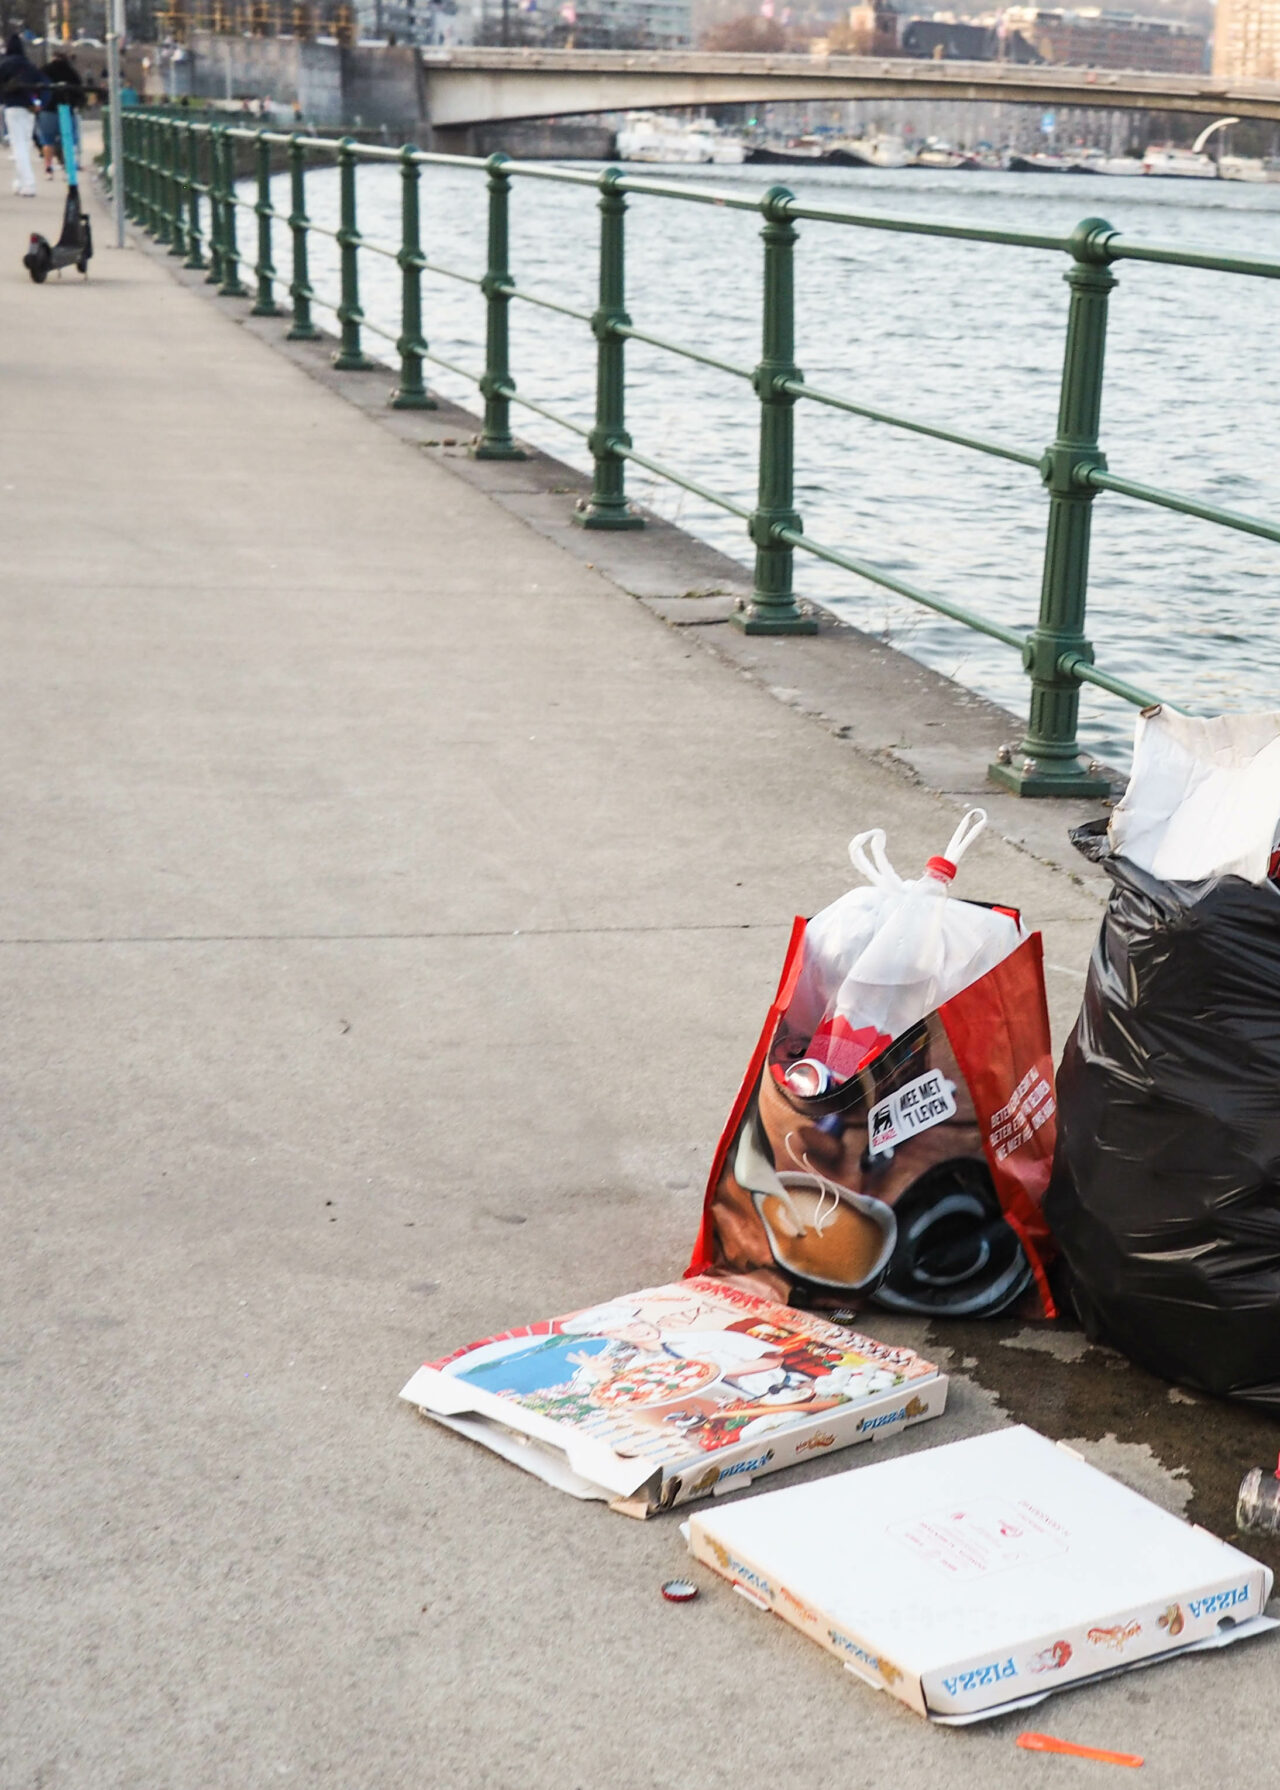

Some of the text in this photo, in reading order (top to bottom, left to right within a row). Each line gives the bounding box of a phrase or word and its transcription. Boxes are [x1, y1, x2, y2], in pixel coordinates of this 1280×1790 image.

[919, 1077, 941, 1101] MET
[914, 1095, 949, 1124] LEVEN
[860, 1407, 907, 1433] PIZZA
[717, 1456, 769, 1482] PIZZA
[1187, 1584, 1249, 1619] PIZZA
[942, 1656, 1018, 1696] PIZZA
